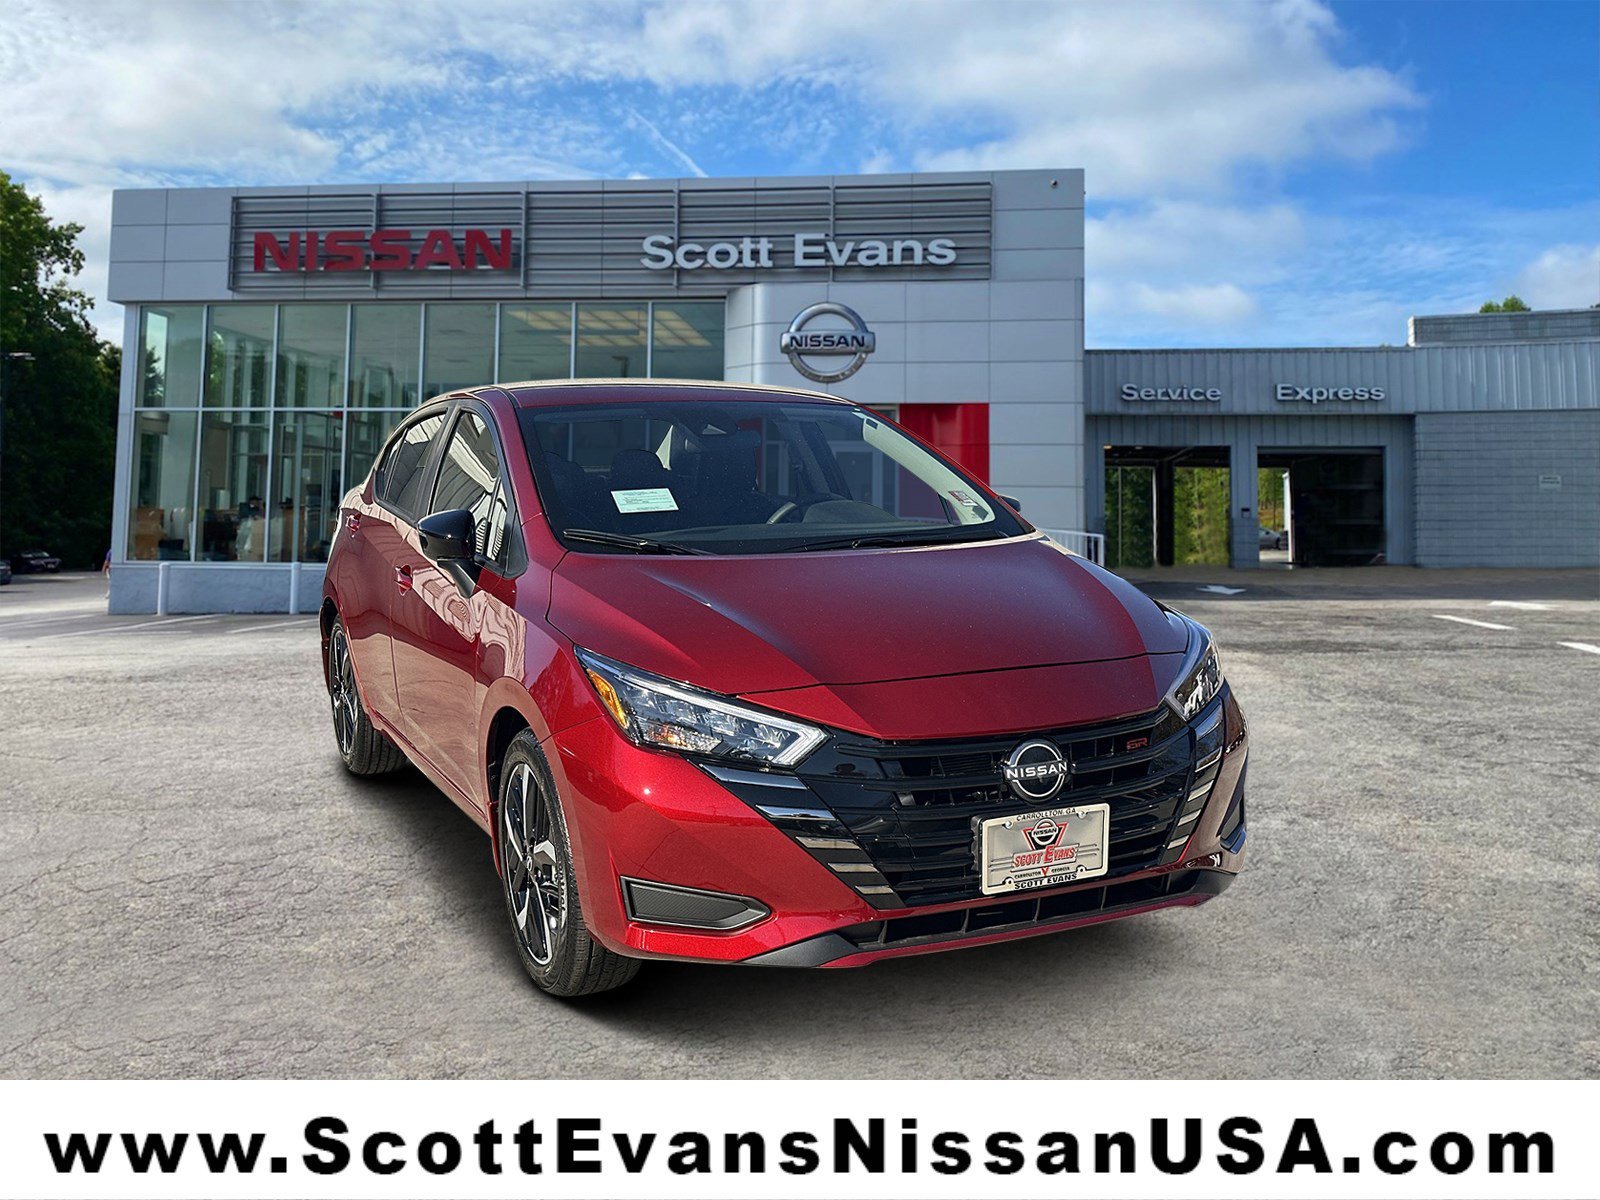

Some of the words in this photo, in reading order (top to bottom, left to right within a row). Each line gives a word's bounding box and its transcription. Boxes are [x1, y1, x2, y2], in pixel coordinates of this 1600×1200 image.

[254, 229, 512, 271] NISSAN
[640, 234, 773, 270] Scott
[794, 233, 957, 267] Evans
[789, 335, 865, 348] NISSAN
[1121, 383, 1222, 401] Service
[1275, 383, 1385, 404] Express
[1125, 737, 1149, 750] SR
[1006, 761, 1068, 779] NISSAN
[1065, 807, 1076, 815] GA
[1033, 828, 1058, 836] NISSAN
[1014, 853, 1043, 868] SCOTT
[1043, 845, 1077, 864] EVANS
[1014, 879, 1044, 890] SCOTT
[1047, 873, 1077, 884] EVANS
